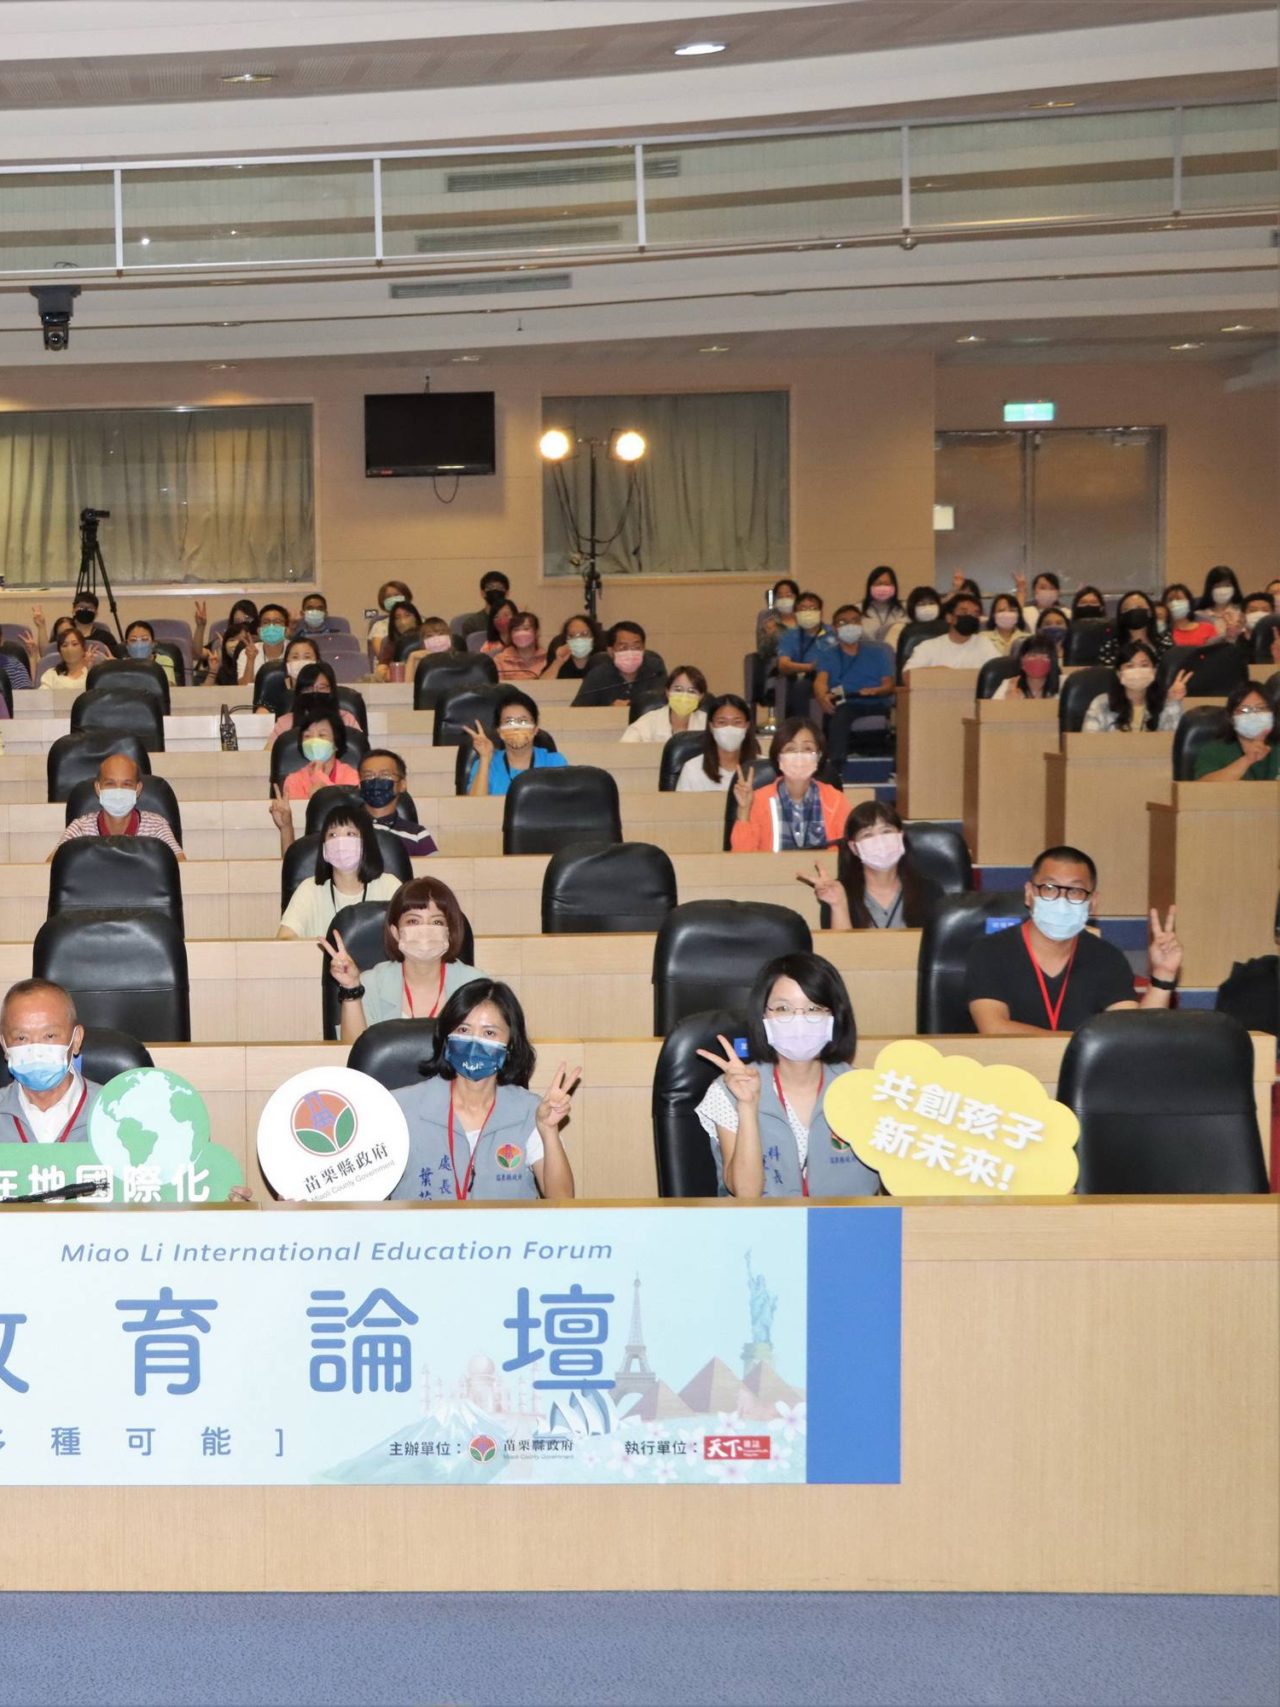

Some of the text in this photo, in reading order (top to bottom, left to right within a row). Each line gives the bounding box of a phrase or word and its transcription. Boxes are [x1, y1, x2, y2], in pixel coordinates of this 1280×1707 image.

[872, 1069, 1045, 1150] 共創孩子
[303, 1142, 389, 1194] 苗栗縣政府
[868, 1115, 1016, 1192] 新未來!
[61, 1240, 613, 1262] Miao Li International Education Forum
[707, 1438, 743, 1458] 天下
